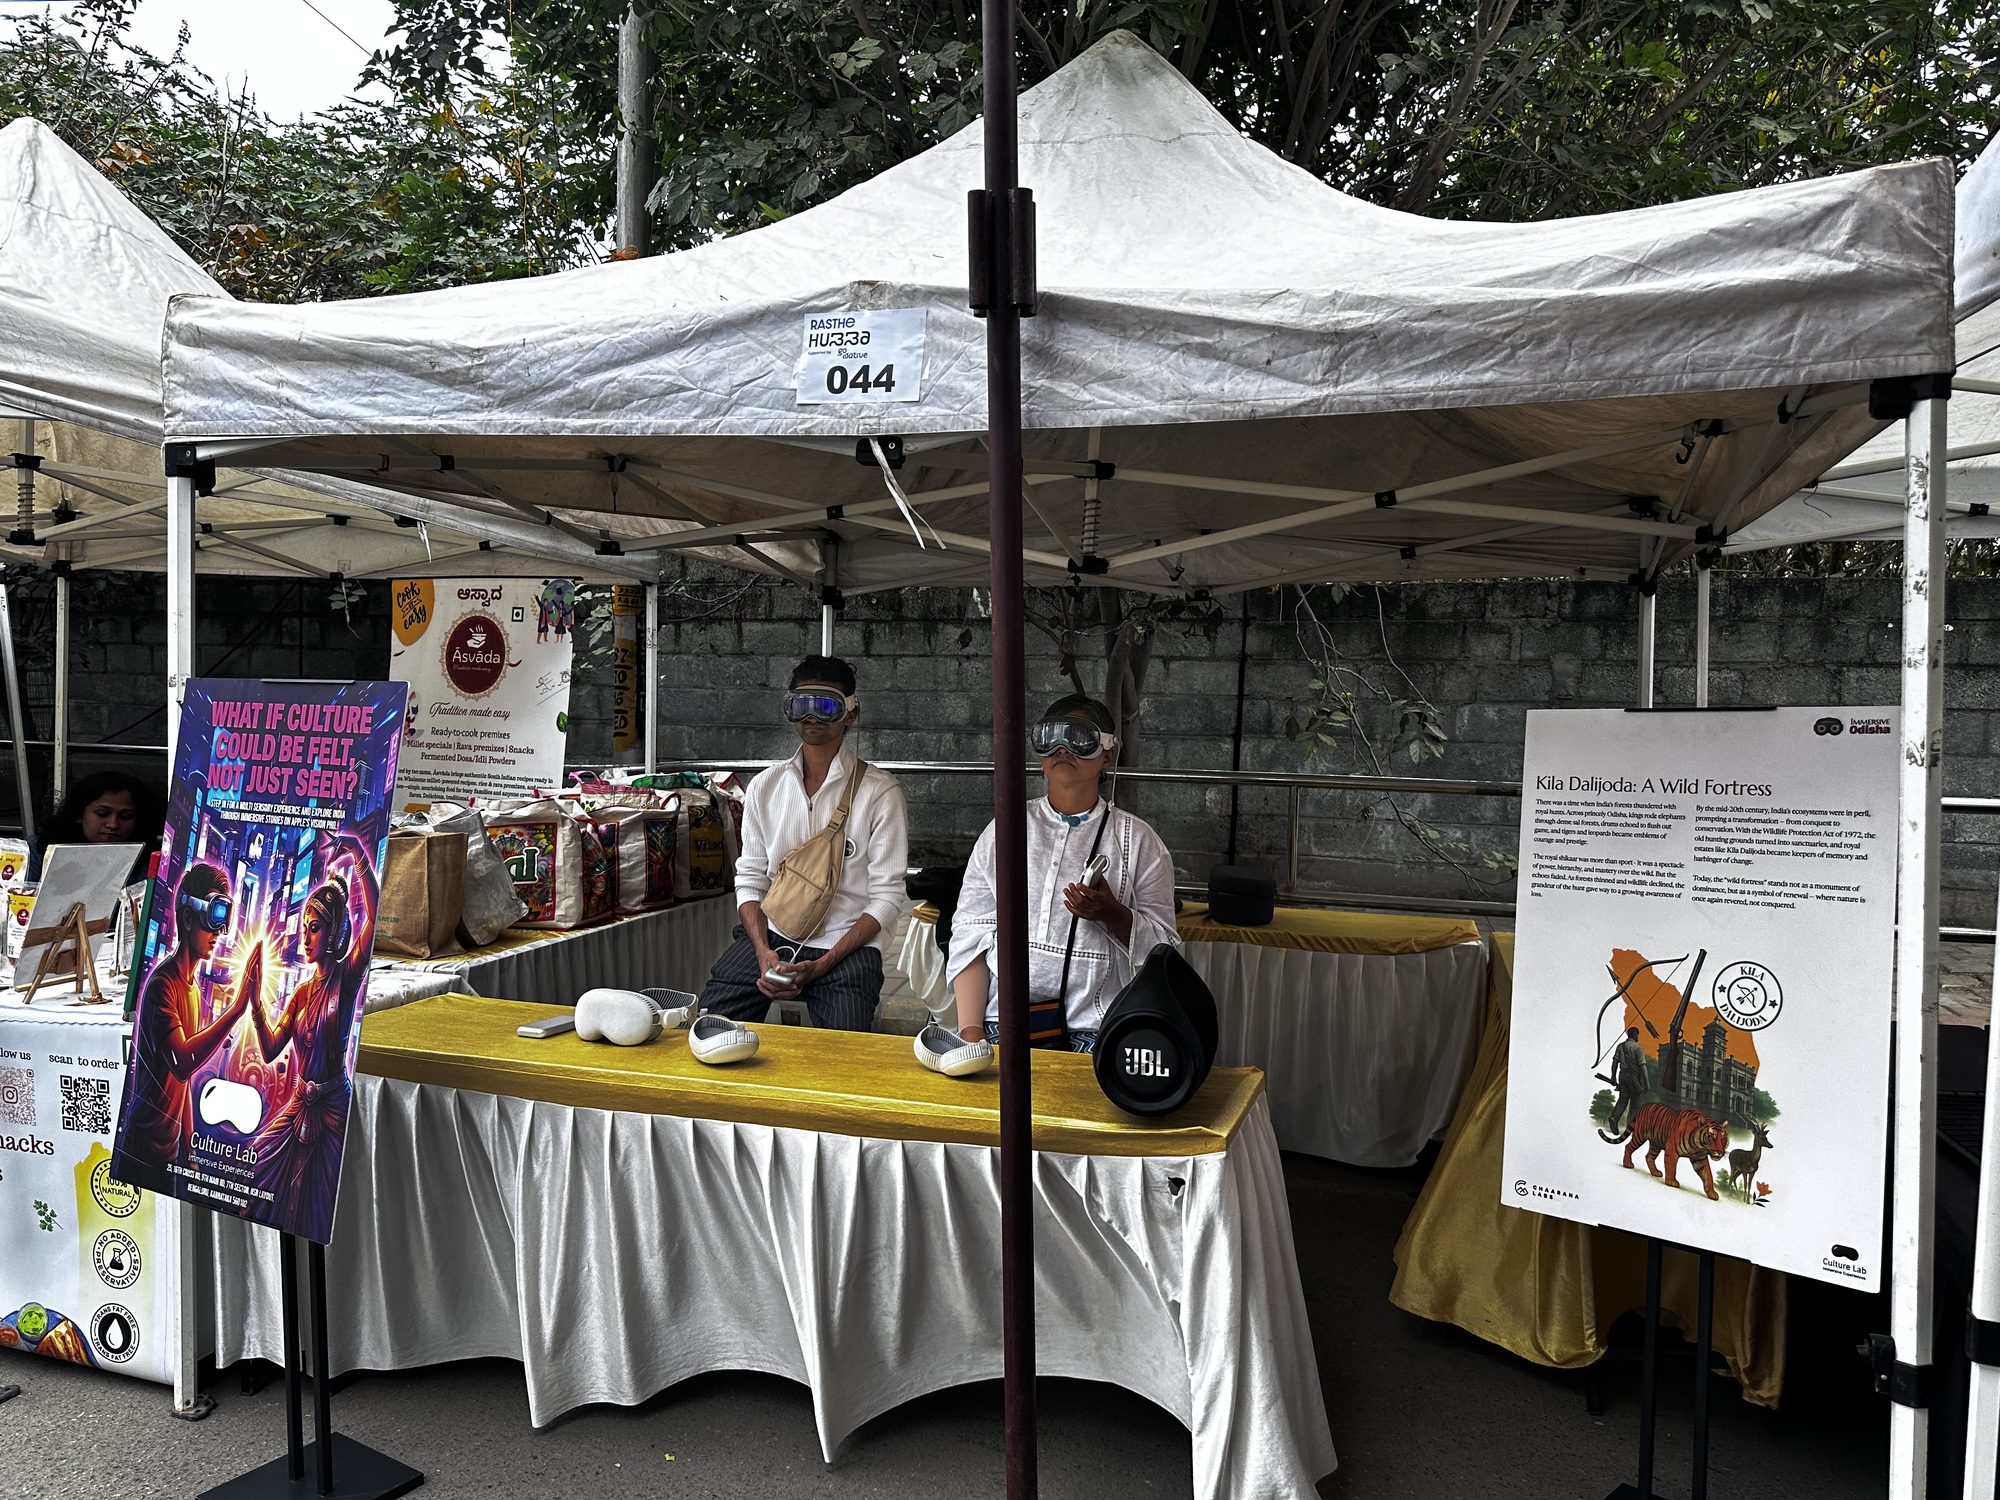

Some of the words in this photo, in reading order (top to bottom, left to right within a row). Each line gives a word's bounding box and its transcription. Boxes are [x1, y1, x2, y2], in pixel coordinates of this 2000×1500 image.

[826, 364, 896, 394] 044
[396, 582, 420, 608] Cook
[457, 585, 502, 607] ಆಸ್ವಾದ
[404, 604, 427, 630] easy
[452, 646, 500, 664] Āsvāda
[212, 701, 264, 728] WHAT
[266, 703, 286, 730] IF
[287, 704, 374, 734] CULTURE
[430, 702, 468, 717] Tradition
[469, 706, 492, 717] made
[493, 709, 510, 720] easy
[431, 727, 478, 739] Ready-to-cook
[480, 729, 510, 740] premixes
[1850, 725, 1890, 734] Odisha
[216, 732, 276, 761] COULD
[278, 735, 305, 764] BE
[307, 737, 356, 772] FELT,
[407, 740, 425, 748] Millet
[425, 741, 452, 750] specials
[456, 742, 472, 751] Rava
[473, 744, 505, 754] premixes
[508, 745, 534, 755] Snacks
[420, 752, 456, 762] Fermented
[456, 754, 488, 764] Dosa/Idli
[488, 756, 516, 766] Powders
[206, 762, 245, 791] NOT
[246, 765, 294, 794] JUST
[295, 768, 358, 800] SEEN?
[1536, 776, 1564, 791] Kila
[1569, 776, 1636, 796] Dalijoda:
[1641, 778, 1655, 793] A
[1660, 778, 1698, 794] Wild
[1705, 779, 1772, 797] Fortress
[210, 799, 221, 808] STEP
[222, 800, 226, 808] IN
[226, 800, 236, 809] FOR
[240, 801, 254, 811] MULTI
[254, 802, 273, 812] SENSORY
[274, 804, 300, 815] EXPERIENCE
[301, 806, 311, 816] AND
[312, 806, 332, 818] EXPLORE
[332, 809, 346, 819] INDIA
[1696, 804, 1704, 812] By
[220, 810, 240, 820] THROUGH
[240, 812, 265, 823] IMMERSIVE
[265, 814, 284, 824] STORIES
[284, 816, 290, 826] ON
[290, 817, 310, 828] APPLE'S
[310, 818, 326, 828] VISION
[1705, 836, 1728, 844] hunting
[1762, 828, 1788, 836] Wildlife
[1844, 831, 1864, 839] 1972,
[1694, 855, 1722, 864] harbinger
[1792, 850, 1816, 858] keepers
[1826, 853, 1854, 861] memory
[1740, 966, 1764, 981] KILA
[1720, 1003, 1768, 1027] DALIJODA
[20, 1052, 32, 1060] us
[48, 1054, 74, 1065] scan
[78, 1056, 89, 1066] to
[90, 1058, 120, 1070] order
[1124, 1048, 1170, 1077] JBL
[190, 1132, 232, 1158] Culture
[236, 1144, 258, 1164] Lab
[188, 1152, 218, 1169] Immersive
[218, 1161, 255, 1179] Experiences
[102, 1186, 132, 1198] NATURAL
[1532, 1184, 1580, 1200] CHAARANA
[1532, 1190, 1553, 1200] LABS
[98, 1235, 108, 1247] NO
[110, 1232, 136, 1252] ADDED
[96, 1250, 139, 1286] PRESERVATIVES
[1822, 1258, 1850, 1270] Culture
[1852, 1264, 1866, 1274] Lab
[94, 1306, 111, 1322] TRANS
[124, 1312, 136, 1329] FREE
[94, 1338, 110, 1358] TRANS
[122, 1344, 136, 1359] FREE
